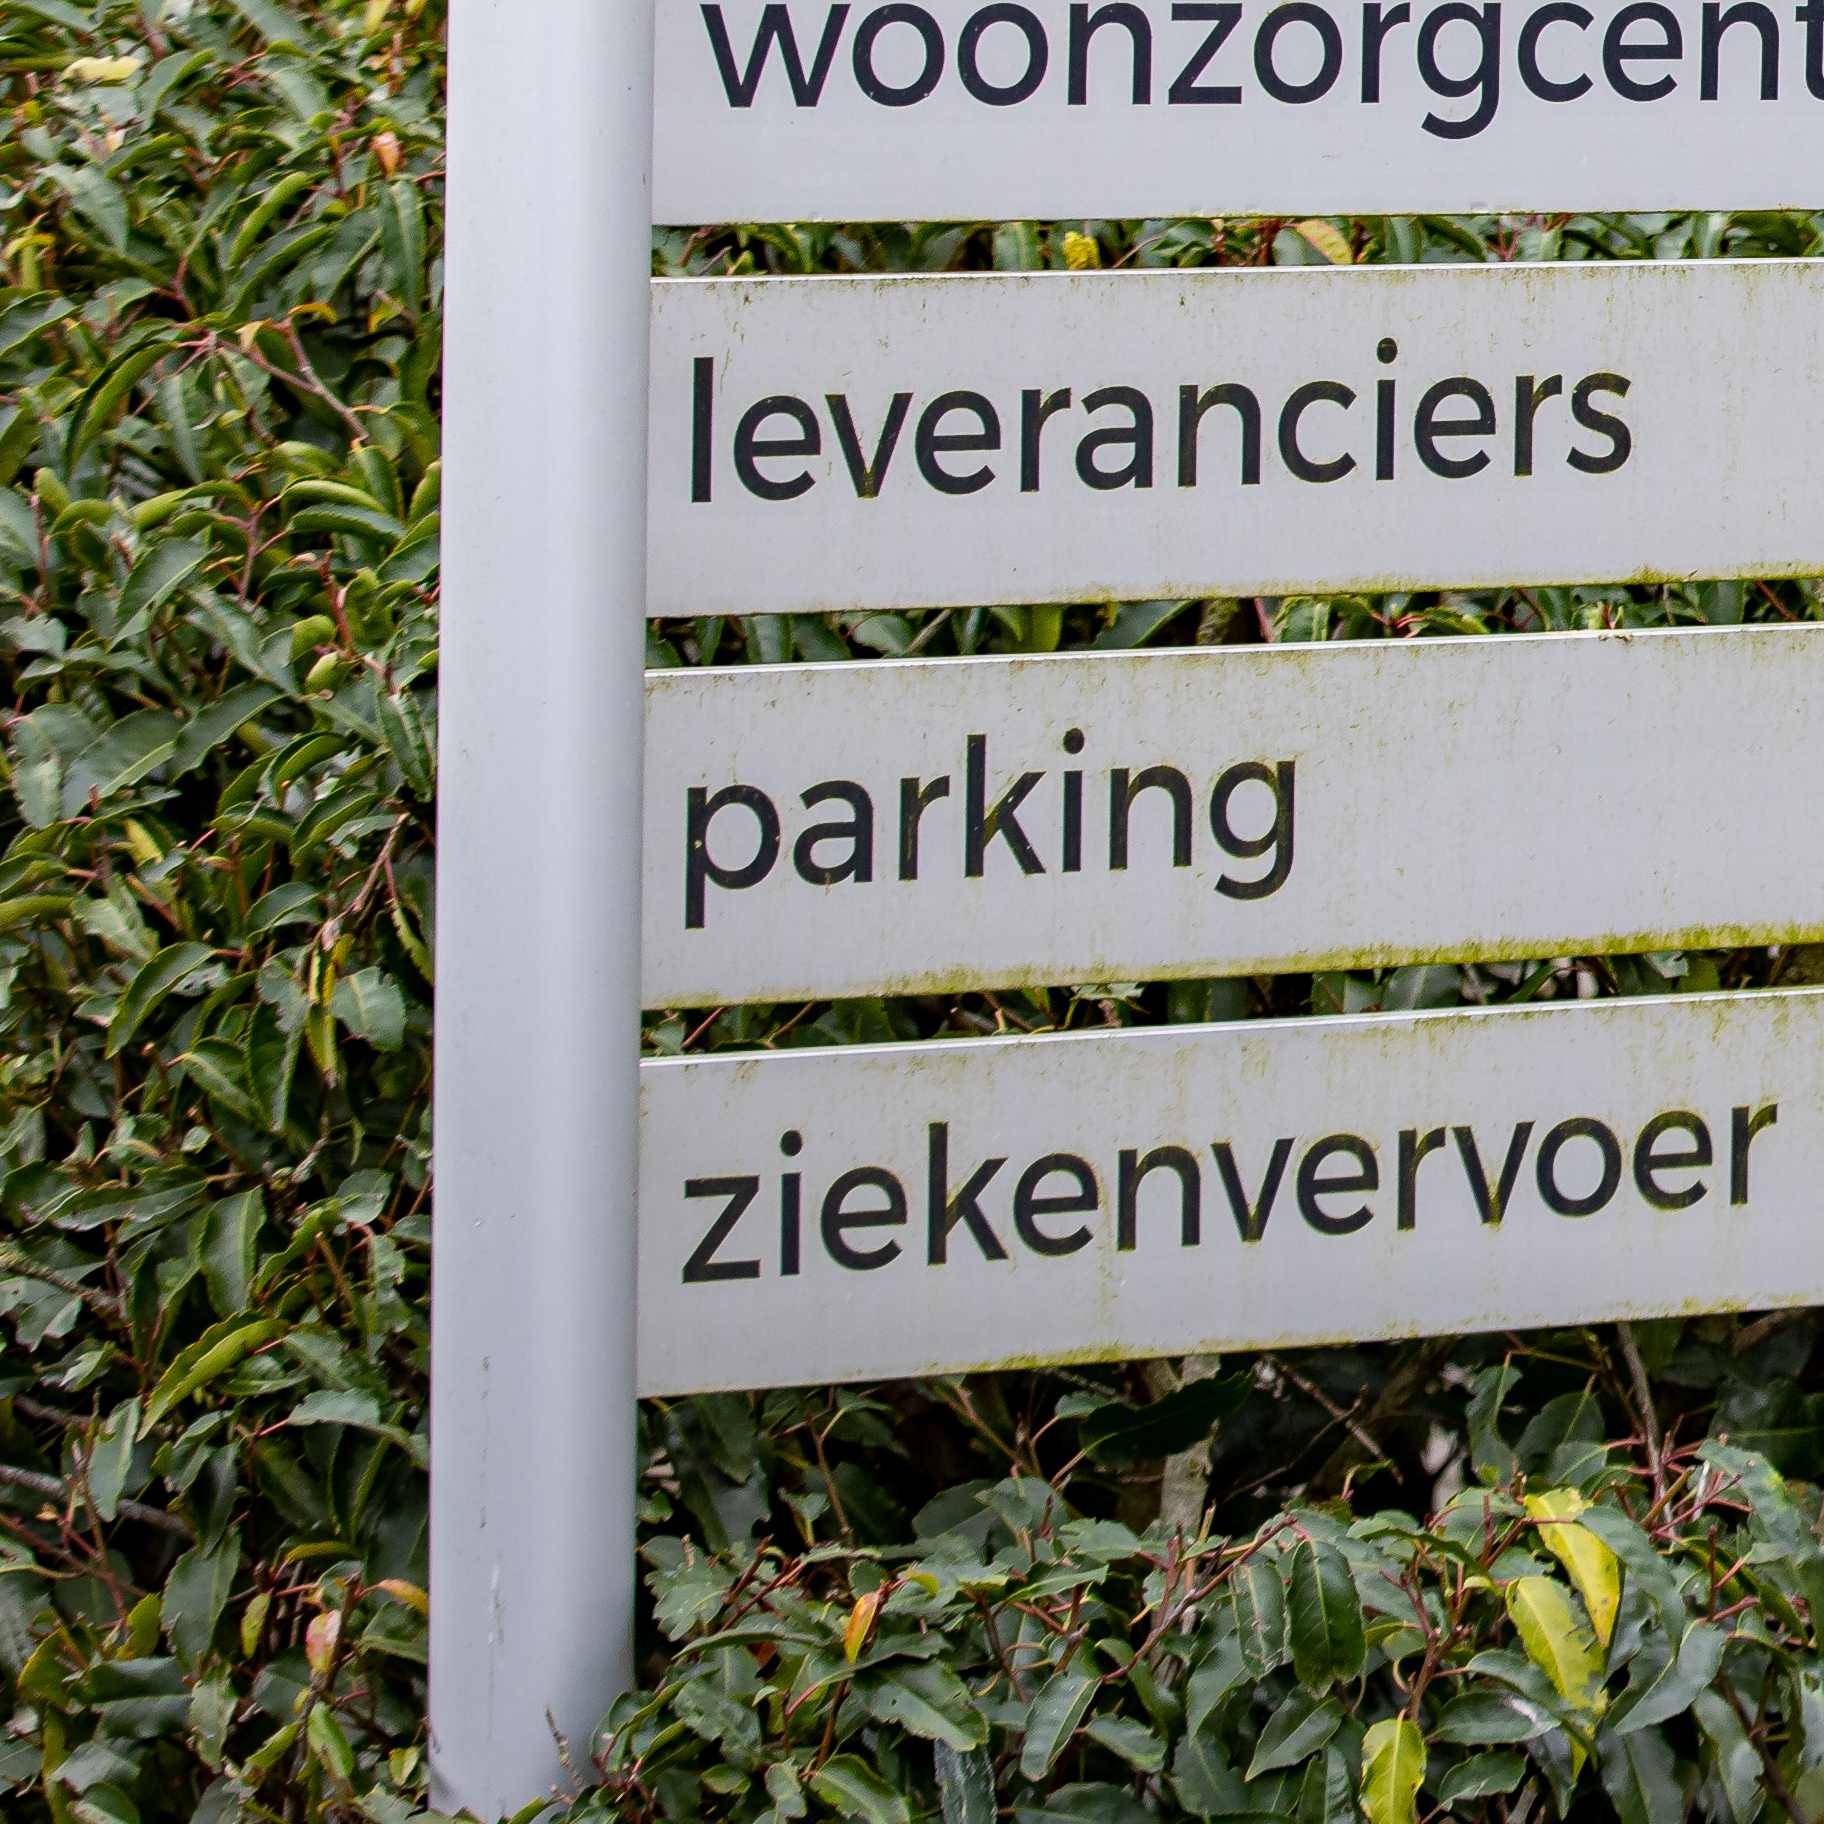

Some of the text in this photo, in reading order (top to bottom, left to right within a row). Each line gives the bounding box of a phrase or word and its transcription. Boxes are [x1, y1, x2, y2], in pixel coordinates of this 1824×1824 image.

[691, 337, 1632, 503] leveranciers
[685, 727, 1296, 930] parking
[682, 1103, 1778, 1284] ziekenvervoer
